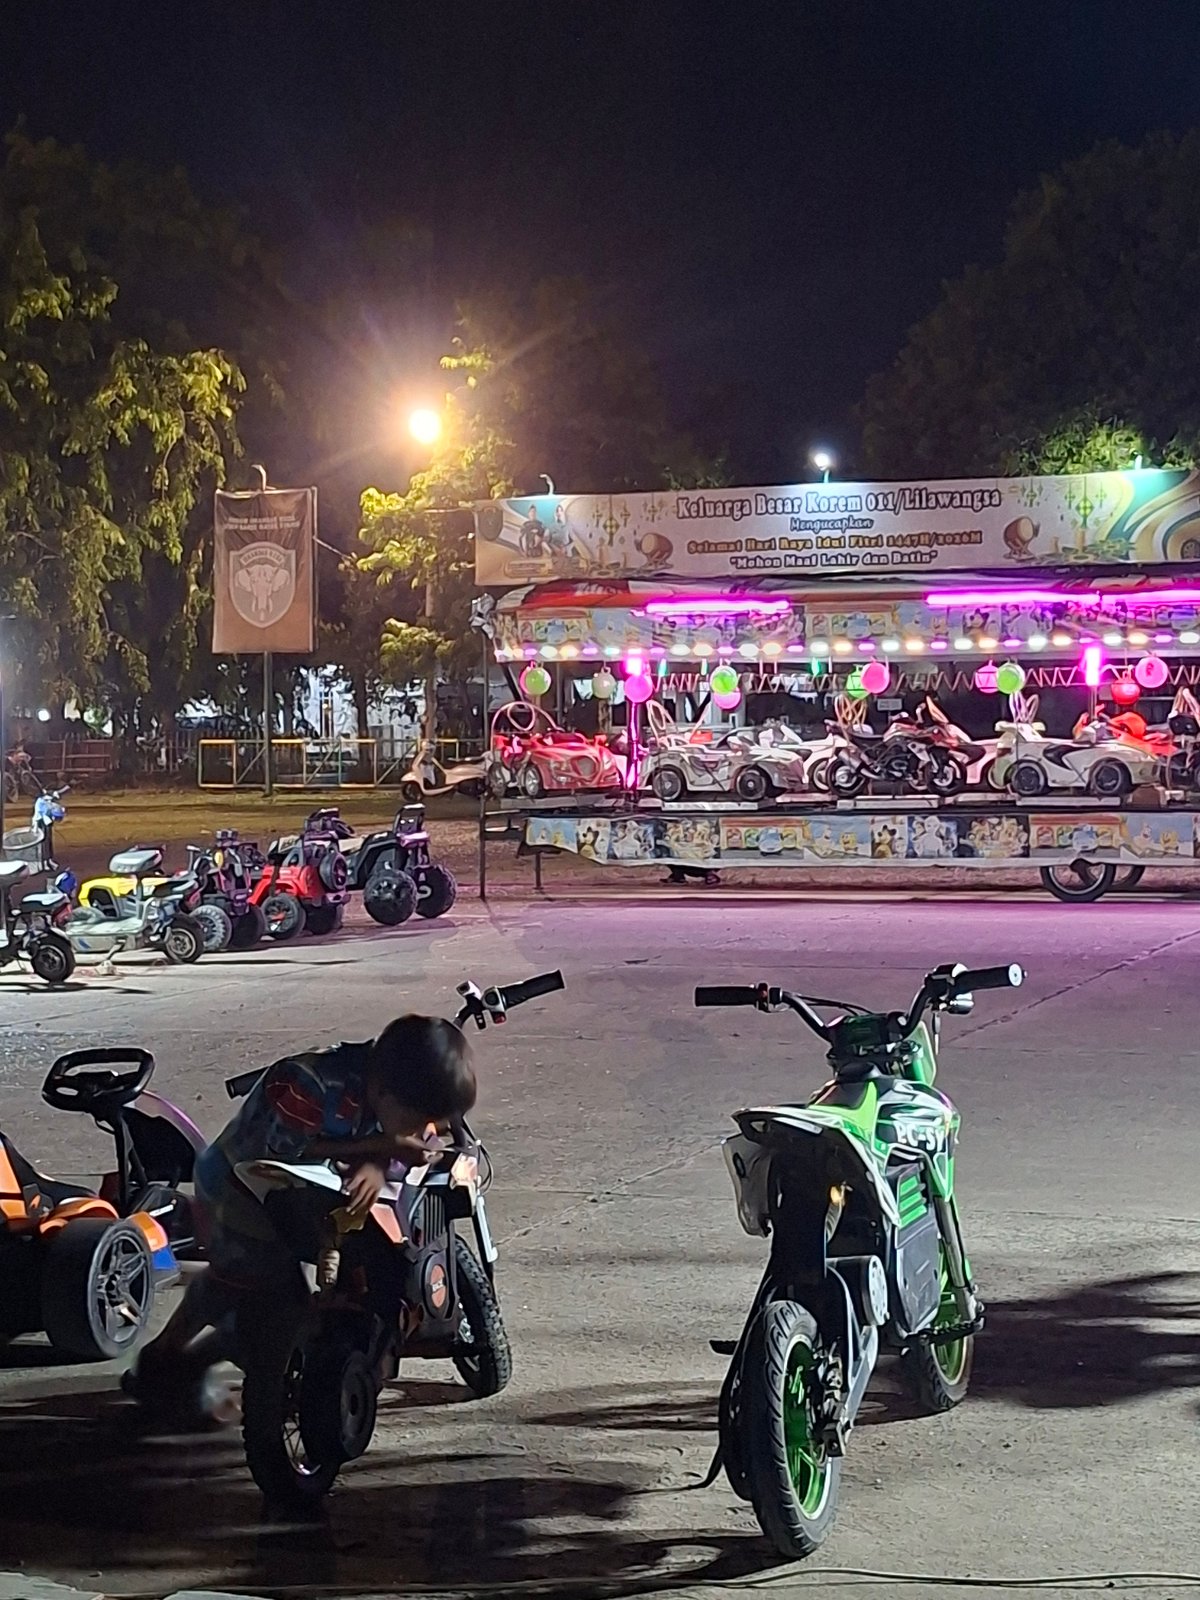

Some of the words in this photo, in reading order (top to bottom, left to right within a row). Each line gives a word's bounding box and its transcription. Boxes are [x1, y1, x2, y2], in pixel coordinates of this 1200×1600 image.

[677, 497, 751, 520] Keluarga
[755, 493, 801, 515] Besar
[805, 491, 862, 512] Korem
[866, 487, 1001, 515] 011/Lilawangsa
[790, 515, 874, 533] Mengucapkan
[687, 539, 742, 554] Selamat
[778, 536, 813, 553] Raya
[784, 554, 818, 568] Maaf
[820, 552, 859, 566] Lahir
[861, 552, 889, 566] dan
